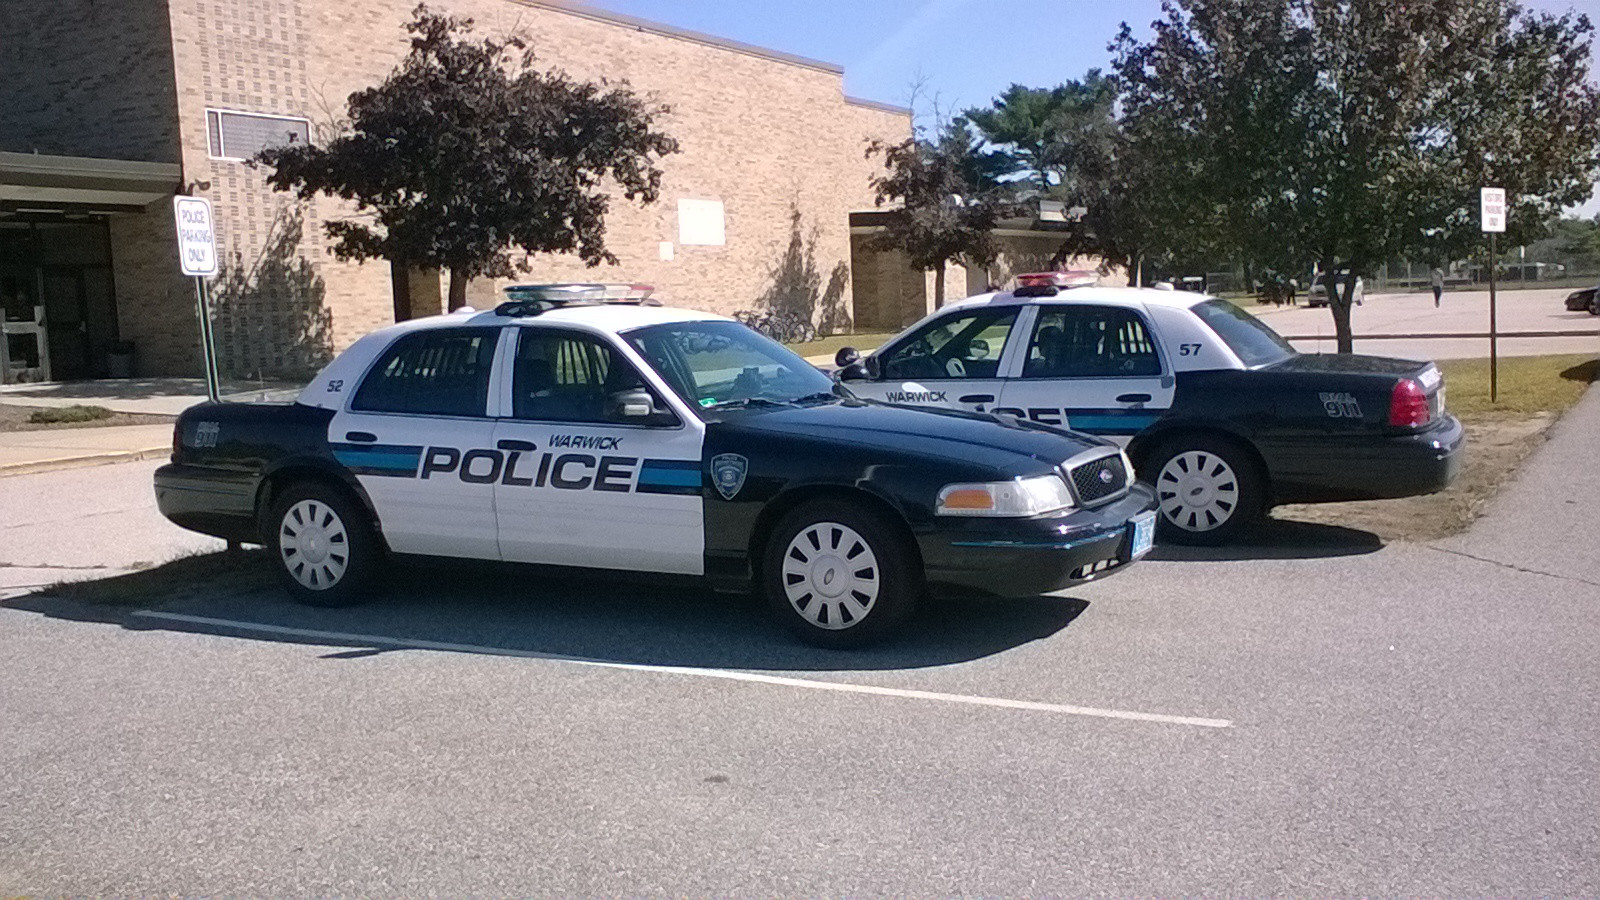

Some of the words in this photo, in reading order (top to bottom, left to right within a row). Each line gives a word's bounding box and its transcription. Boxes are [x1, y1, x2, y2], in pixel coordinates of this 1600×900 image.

[181, 209, 206, 224] POLICE
[181, 229, 212, 243] PARKING
[188, 248, 206, 262] ONLY
[1179, 343, 1202, 356] 57
[327, 389, 344, 402] 52
[885, 391, 948, 403] WARWICK
[1324, 401, 1363, 418] 911
[194, 431, 219, 448] 911
[548, 433, 623, 450] WARWICK
[421, 446, 637, 492] POLICE
